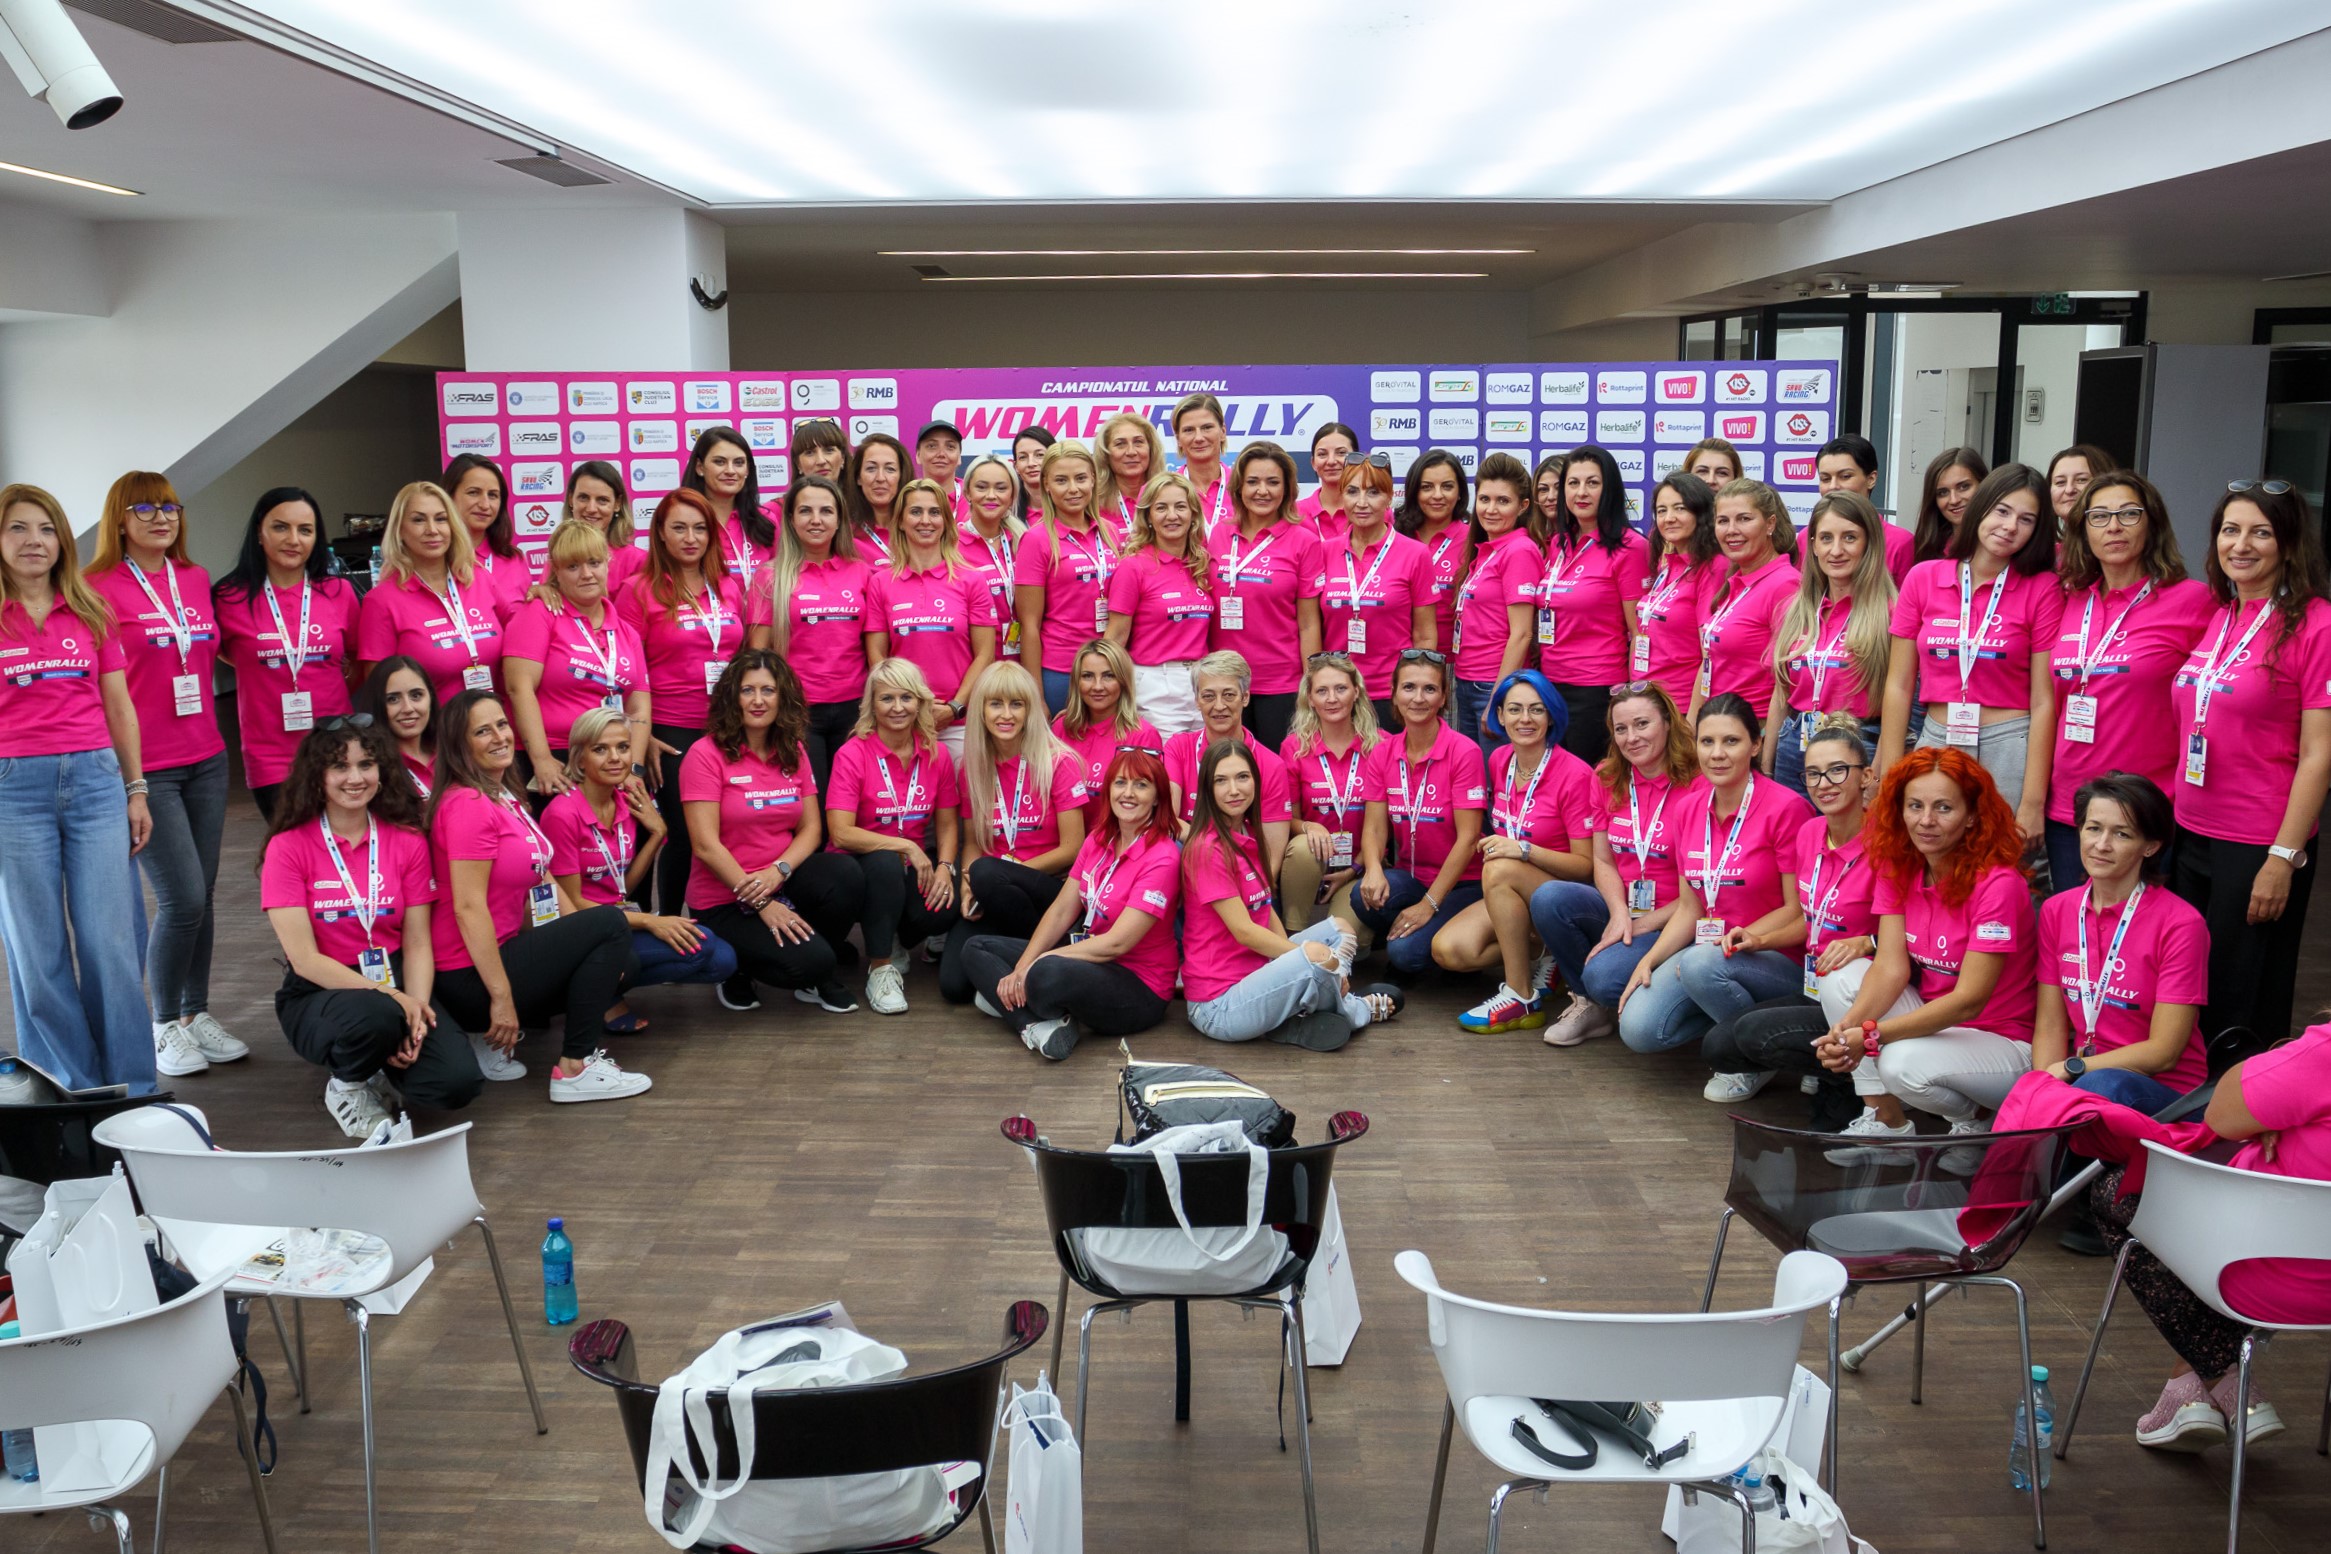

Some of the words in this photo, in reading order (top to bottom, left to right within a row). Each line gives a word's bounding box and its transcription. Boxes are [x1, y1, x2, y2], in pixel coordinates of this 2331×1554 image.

[752, 386, 778, 395] Castrol
[1041, 381, 1150, 393] CAMPIONATUL
[1487, 384, 1531, 393] ROMGAZ
[1545, 384, 1581, 393] Herbalife
[1610, 384, 1644, 392] Rottaprint
[1668, 383, 1692, 395] VIVO!
[866, 387, 894, 398] RMB
[1784, 390, 1810, 398] RACING
[456, 394, 494, 402] FRAS
[1389, 417, 1417, 429] RMB
[1542, 422, 1586, 431] ROMGAZ
[1600, 423, 1638, 432] Herbalife
[1668, 424, 1702, 432] Rottaprint
[1727, 422, 1751, 435] VIVO!
[521, 433, 558, 441] FRAS
[1459, 455, 1474, 466] MB
[1618, 462, 1642, 470] GAZ
[1743, 463, 1762, 471] print
[1787, 463, 1812, 476] VIVO!
[800, 606, 859, 615] WOMENRALLY
[892, 615, 954, 627] WOMENRALLY
[4, 659, 91, 676] WOMENRALLY
[744, 786, 797, 799] WOMENRALLY
